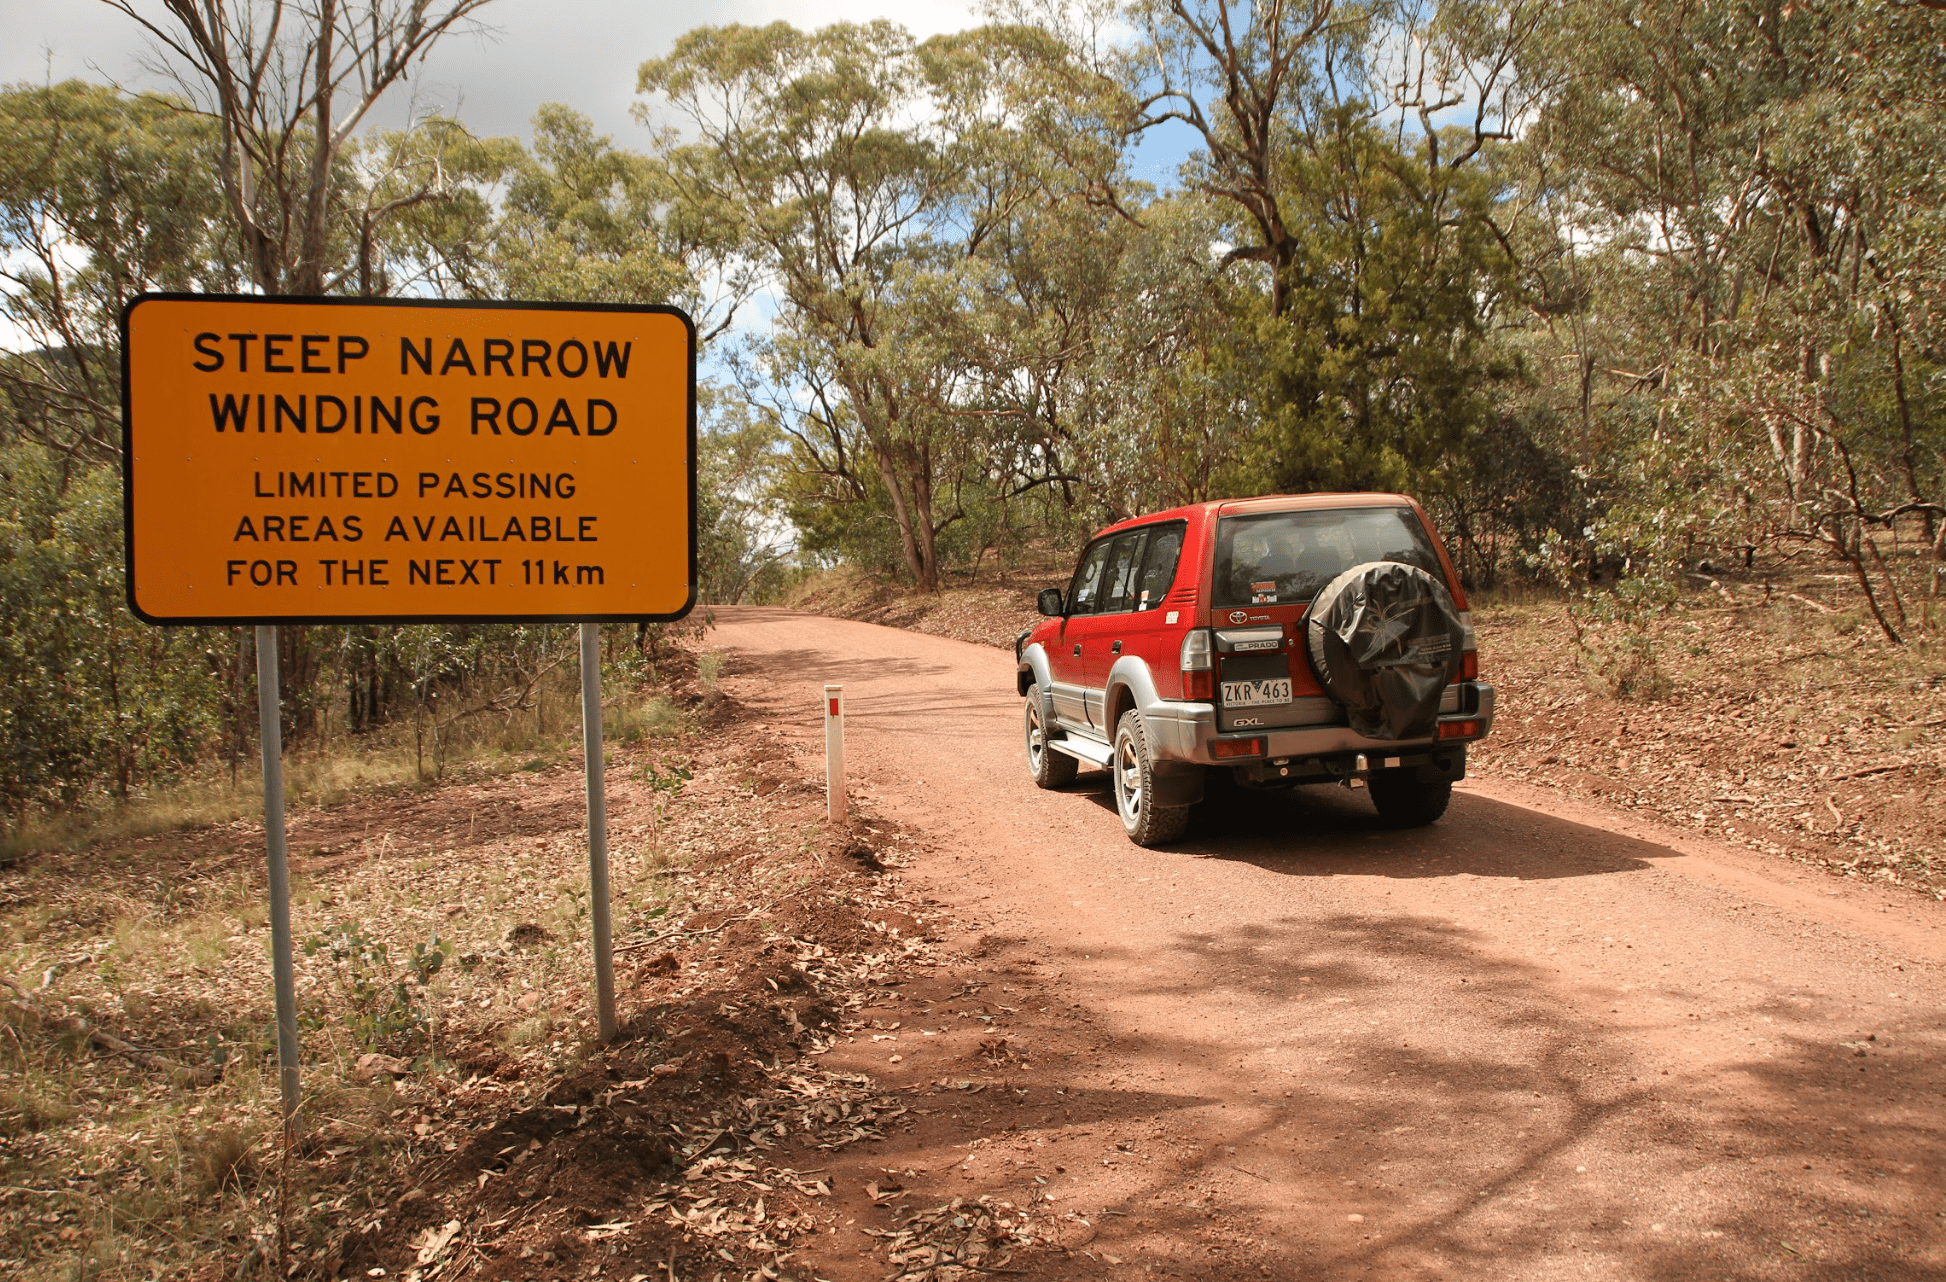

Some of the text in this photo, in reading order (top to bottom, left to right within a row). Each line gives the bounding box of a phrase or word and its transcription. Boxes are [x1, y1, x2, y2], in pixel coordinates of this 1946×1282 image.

[192, 331, 632, 379] STEEP NARROW
[208, 393, 618, 437] WINDING ROAD
[254, 471, 576, 499] LIMITED PASSING
[233, 515, 598, 542] AREAS AVAILABLE
[226, 559, 605, 587] FOR THE NEXT 11km
[1248, 641, 1278, 649] PRADO
[1225, 682, 1289, 702] ZKR 463
[1233, 717, 1265, 727] GXL
